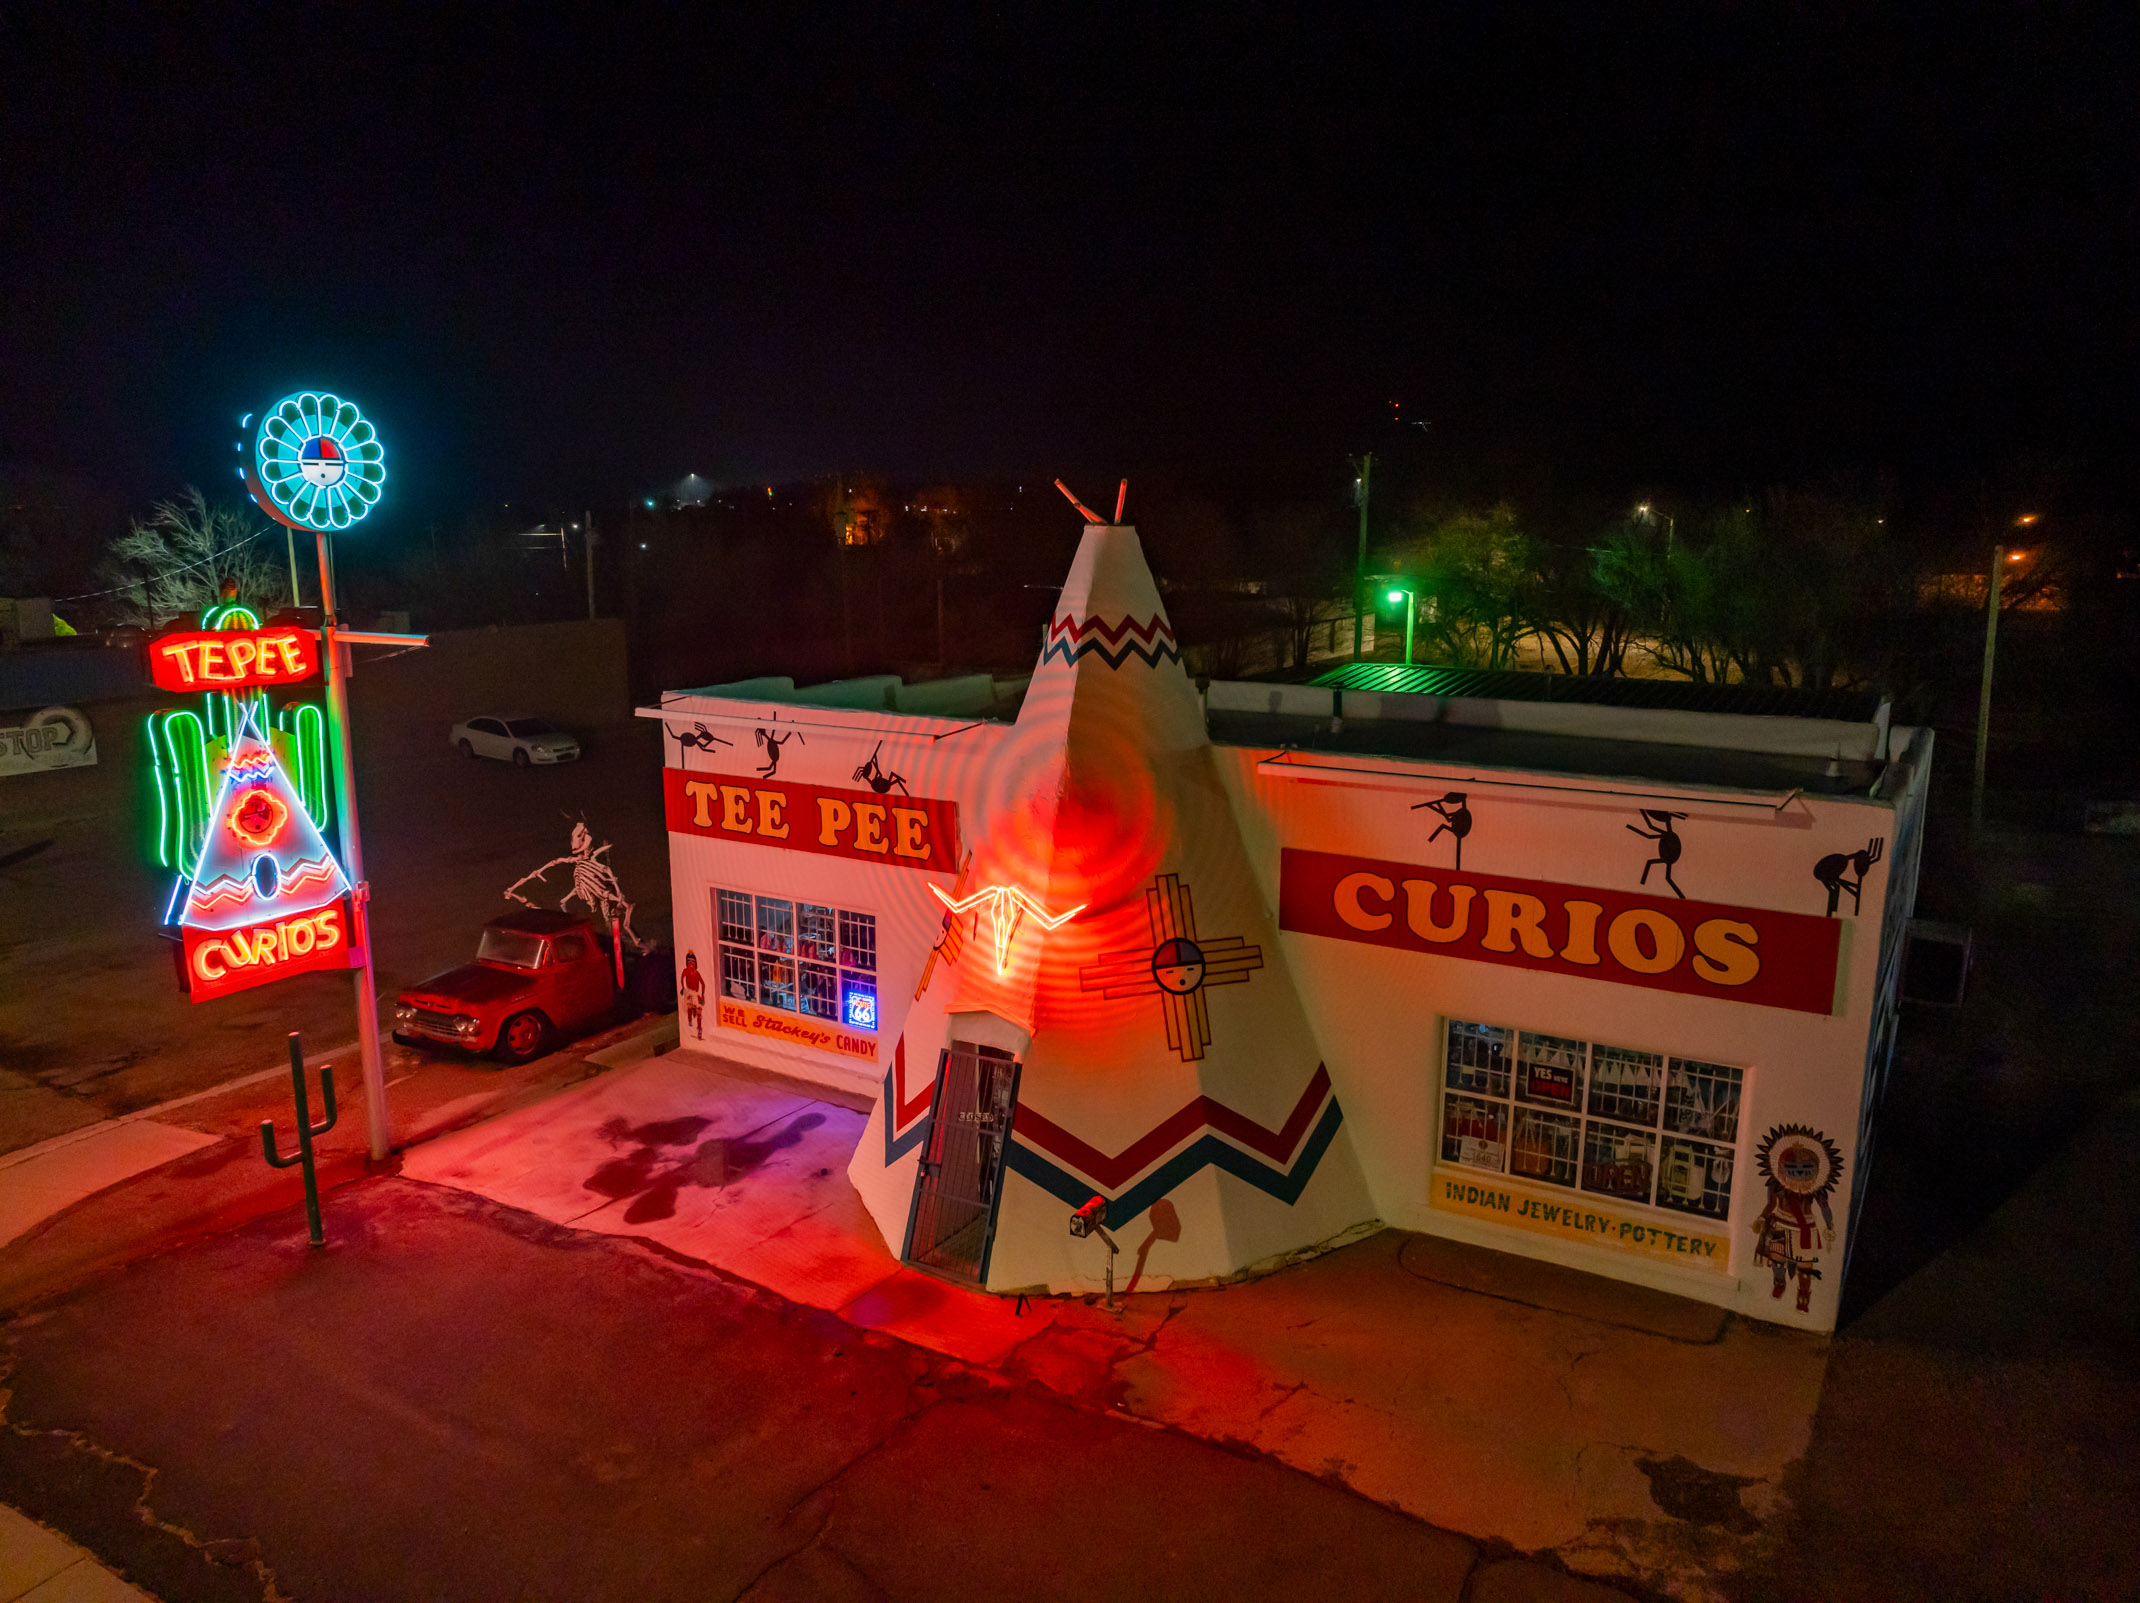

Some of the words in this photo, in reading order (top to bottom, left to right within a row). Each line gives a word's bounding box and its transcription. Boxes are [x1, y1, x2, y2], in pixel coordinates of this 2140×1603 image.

[161, 634, 308, 683] TEPEE
[684, 780, 791, 840] TEE
[816, 797, 933, 861] PEE
[192, 909, 342, 983] CURIOS
[1332, 871, 1761, 988] CURIOS
[724, 1005, 745, 1017] WE
[854, 1006, 870, 1021] 66
[722, 1013, 748, 1028] SELL
[752, 1014, 831, 1045] Stuckey's
[836, 1034, 877, 1057] CANDY
[1530, 1079, 1570, 1099] OPEN
[1533, 1066, 1552, 1080] YES
[1445, 1181, 1511, 1213] INDIAN
[1517, 1199, 1612, 1235] JEWELRY
[1619, 1222, 1717, 1258] POTTERY
